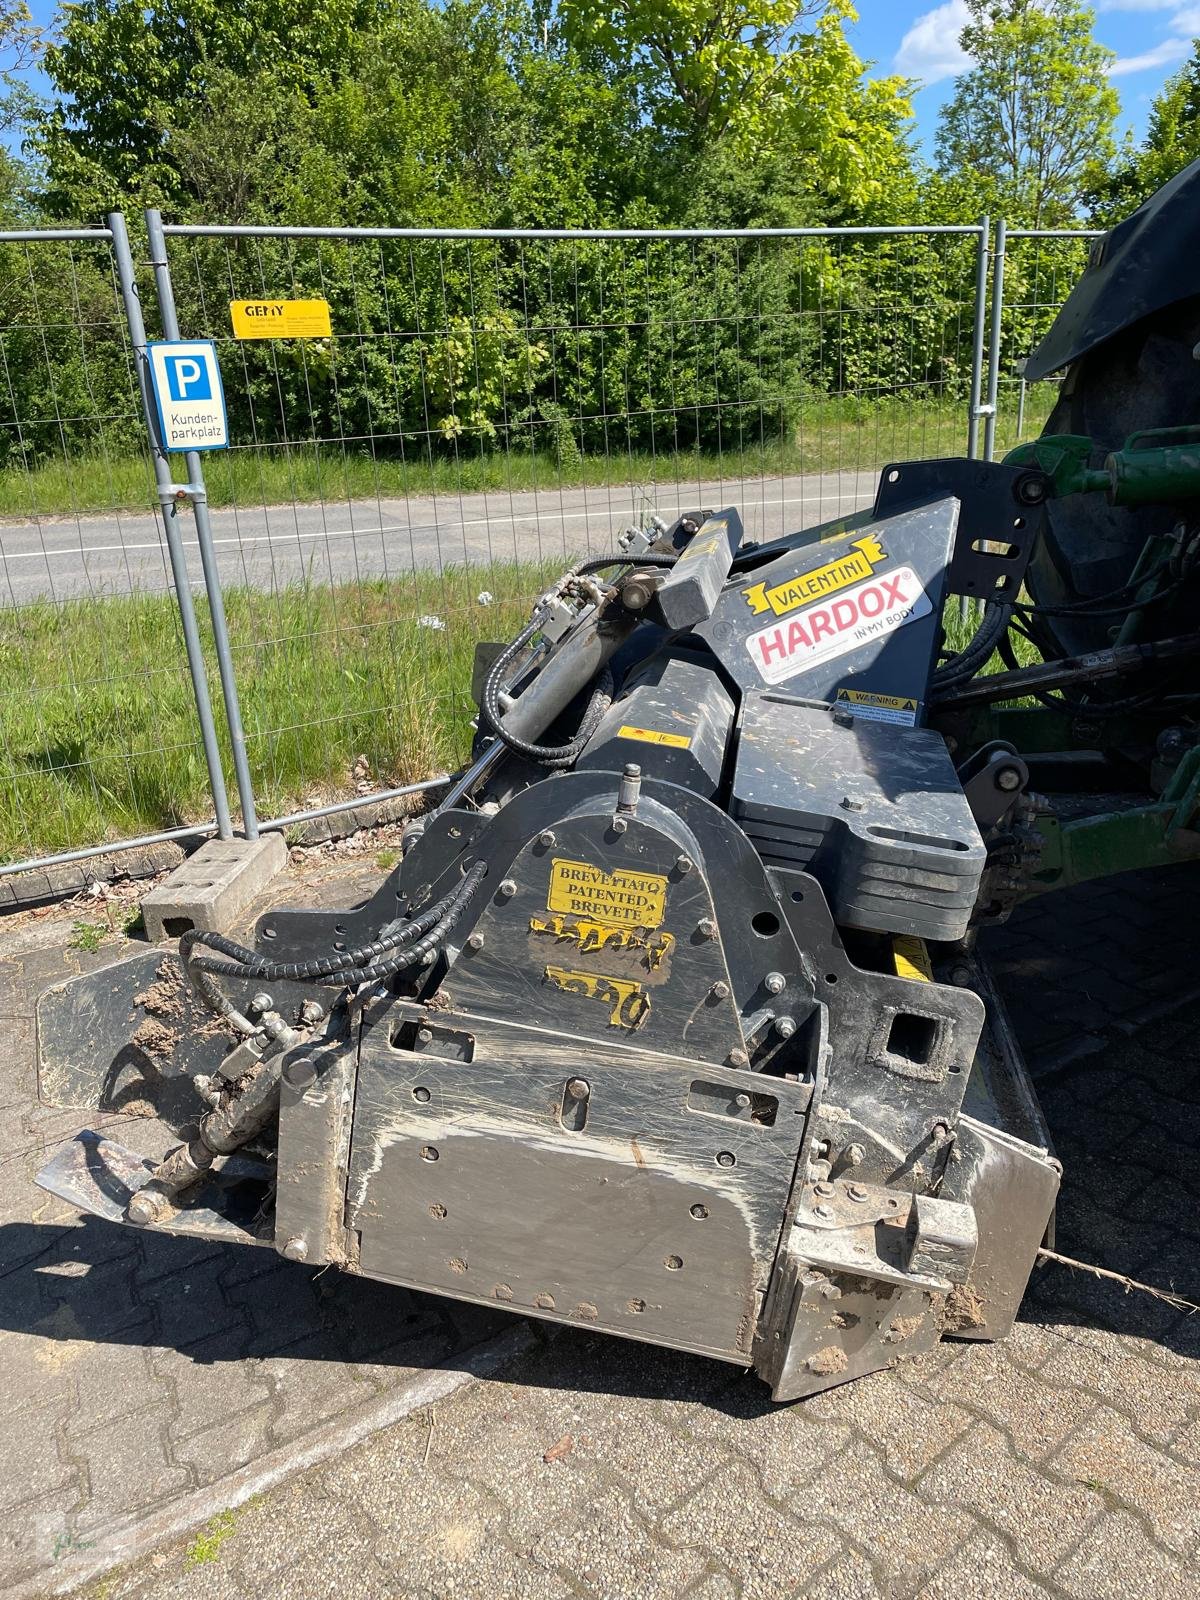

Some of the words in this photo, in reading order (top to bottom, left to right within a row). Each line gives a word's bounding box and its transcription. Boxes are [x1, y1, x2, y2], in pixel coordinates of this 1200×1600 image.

[174, 359, 201, 398] P
[171, 413, 219, 425] Kunden-
[171, 427, 222, 441] parkplatz
[775, 559, 864, 606] VALENTINI
[854, 630, 868, 641] IN
[867, 621, 885, 636] MY
[886, 606, 915, 626] BODY
[856, 693, 899, 706] WARNING
[560, 867, 660, 894] BREVETTATO
[568, 884, 648, 907] PATENTED
